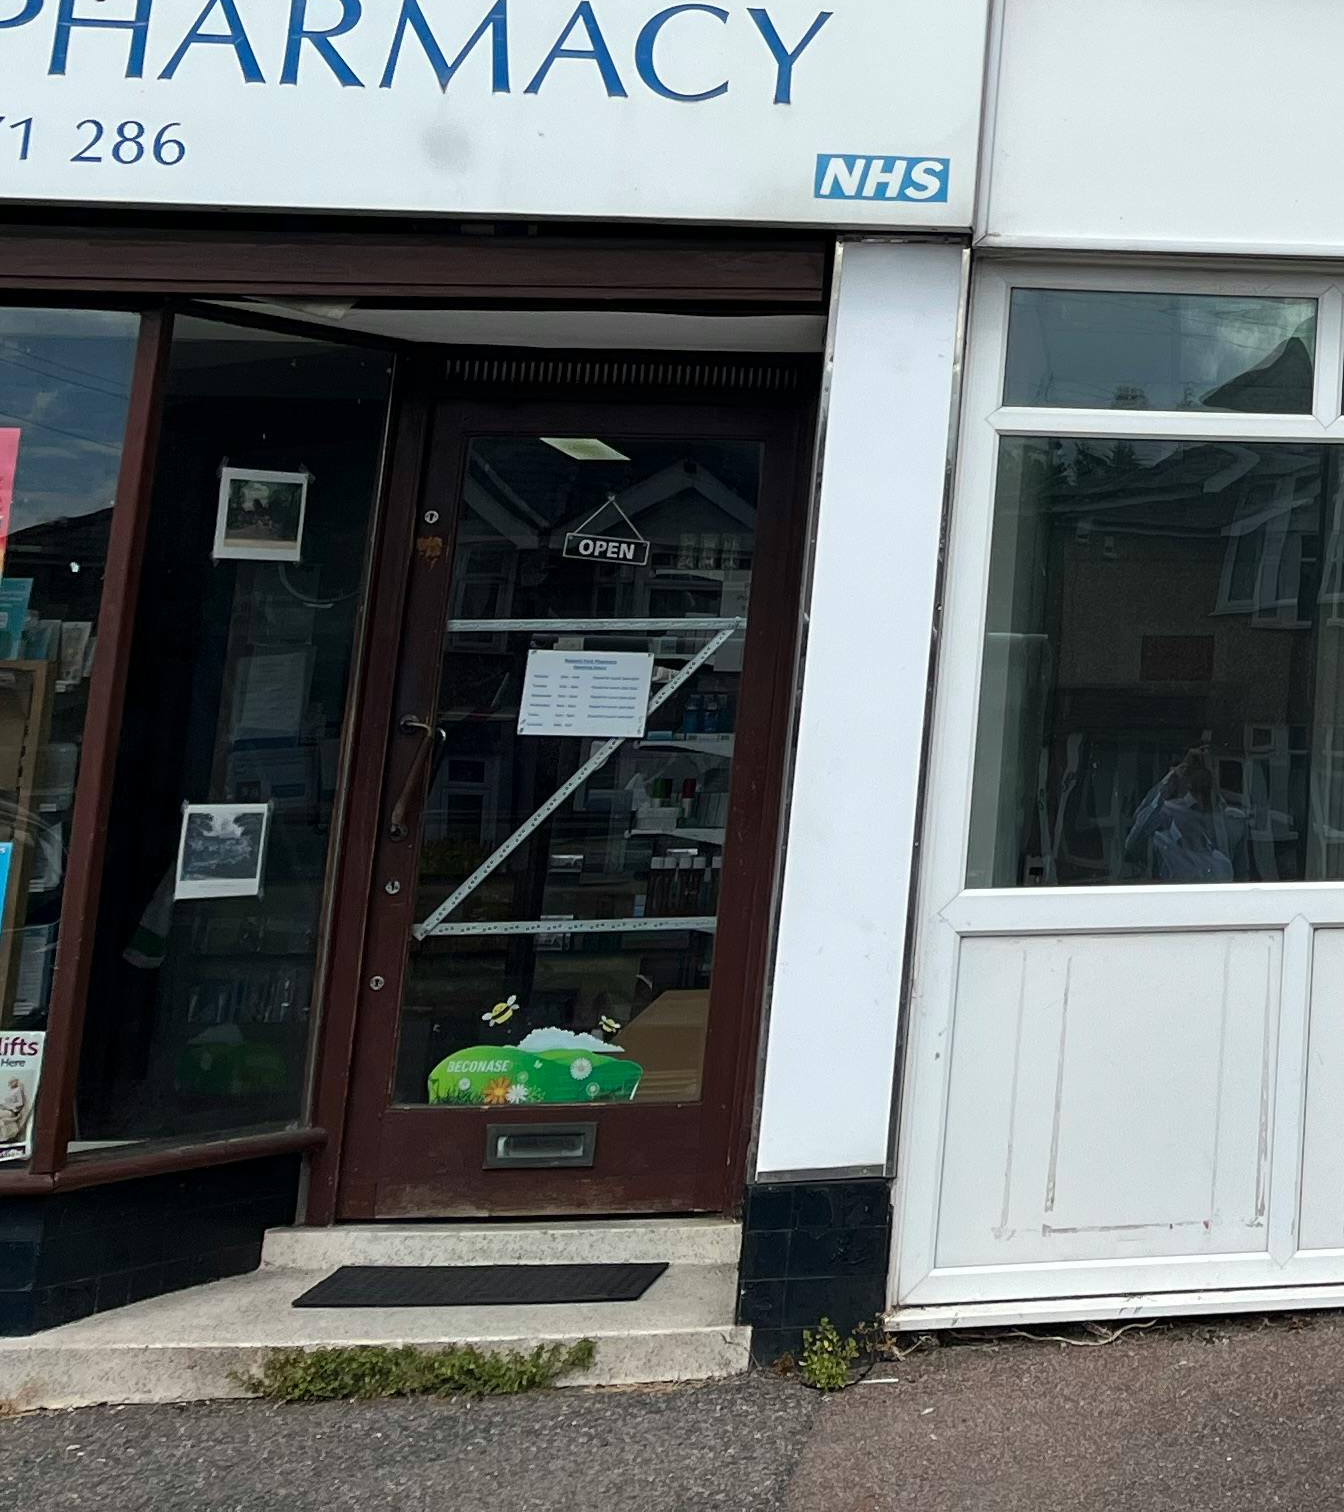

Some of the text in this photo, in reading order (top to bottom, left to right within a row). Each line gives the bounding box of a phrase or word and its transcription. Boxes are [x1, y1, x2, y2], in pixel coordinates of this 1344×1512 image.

[70, 119, 186, 166] 286
[819, 157, 944, 200] NHS
[578, 539, 635, 560] OPEN
[1, 1058, 26, 1067] Here
[448, 1060, 509, 1072] BECONASE
